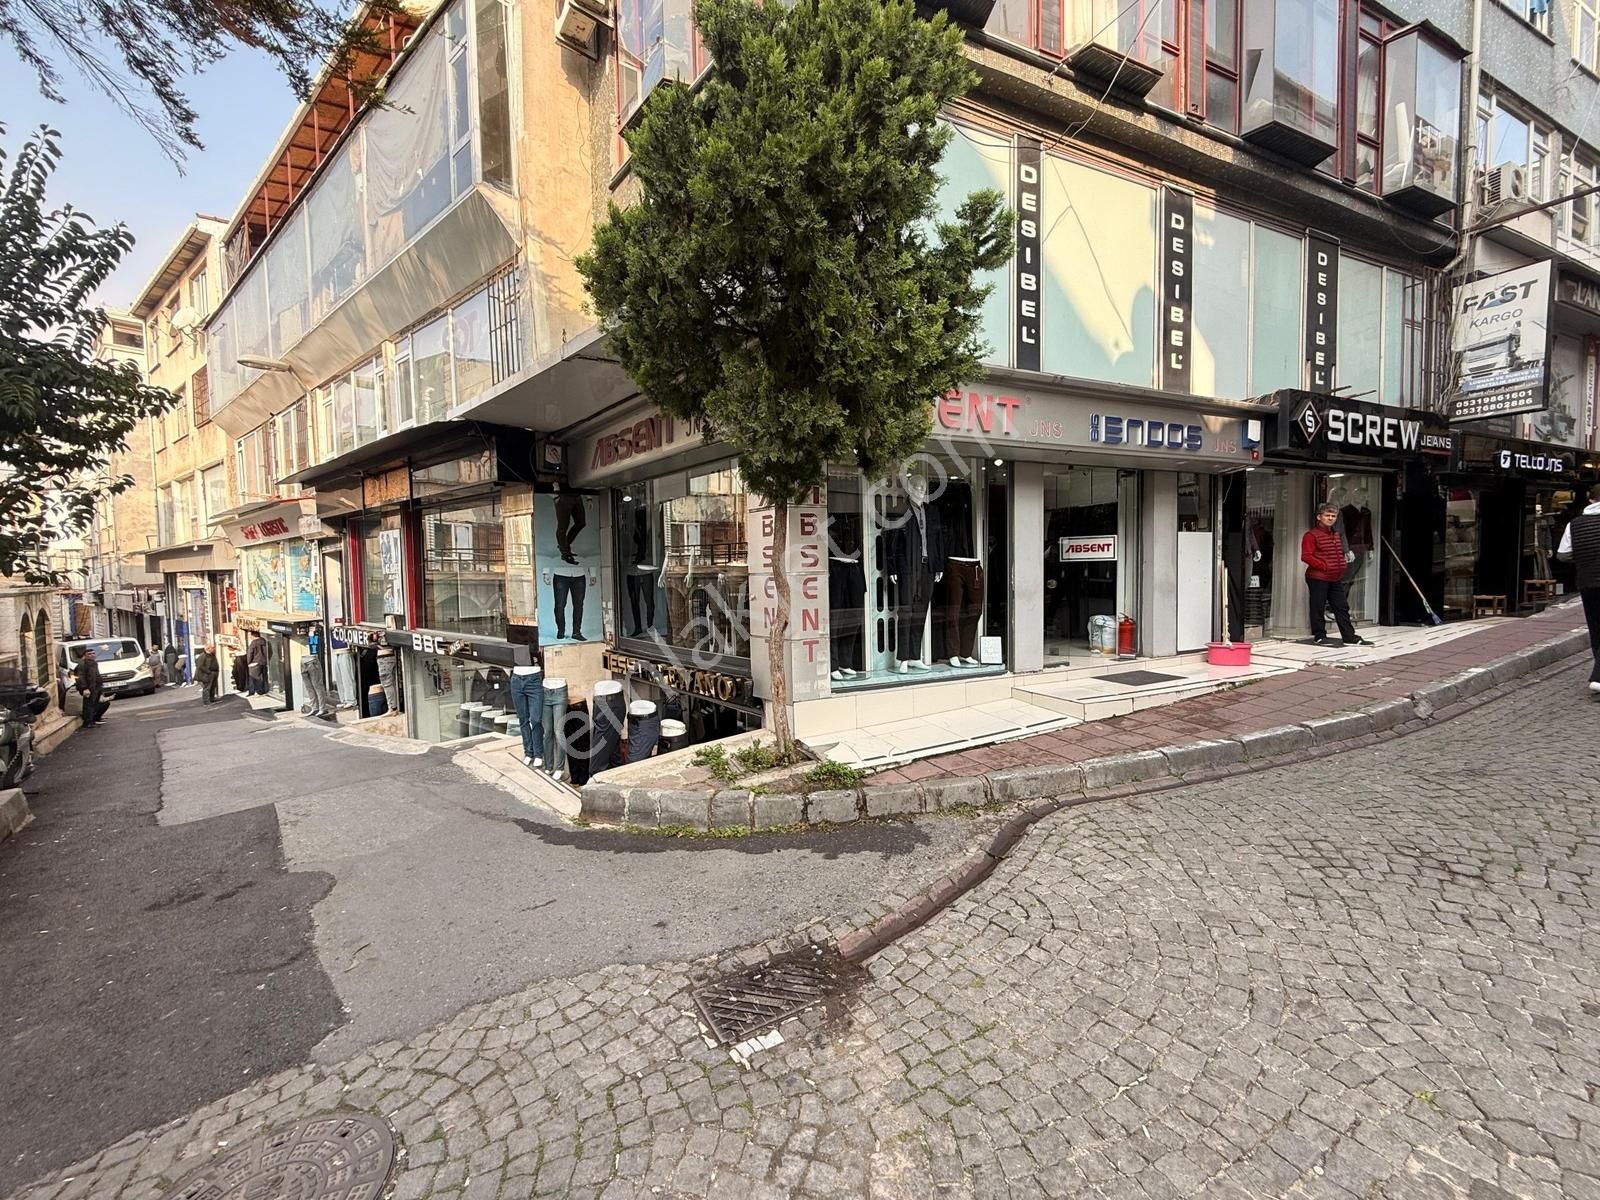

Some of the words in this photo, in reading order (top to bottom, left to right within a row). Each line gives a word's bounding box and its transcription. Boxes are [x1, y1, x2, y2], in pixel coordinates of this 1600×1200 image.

[1461, 279, 1538, 315] FAST
[1470, 308, 1523, 329] KARGO
[1030, 420, 1063, 439] JNS
[1327, 409, 1420, 450] SCREW
[1420, 433, 1452, 449] JEANS
[1065, 543, 1112, 554] ABSENT
[332, 627, 369, 646] COLOMER
